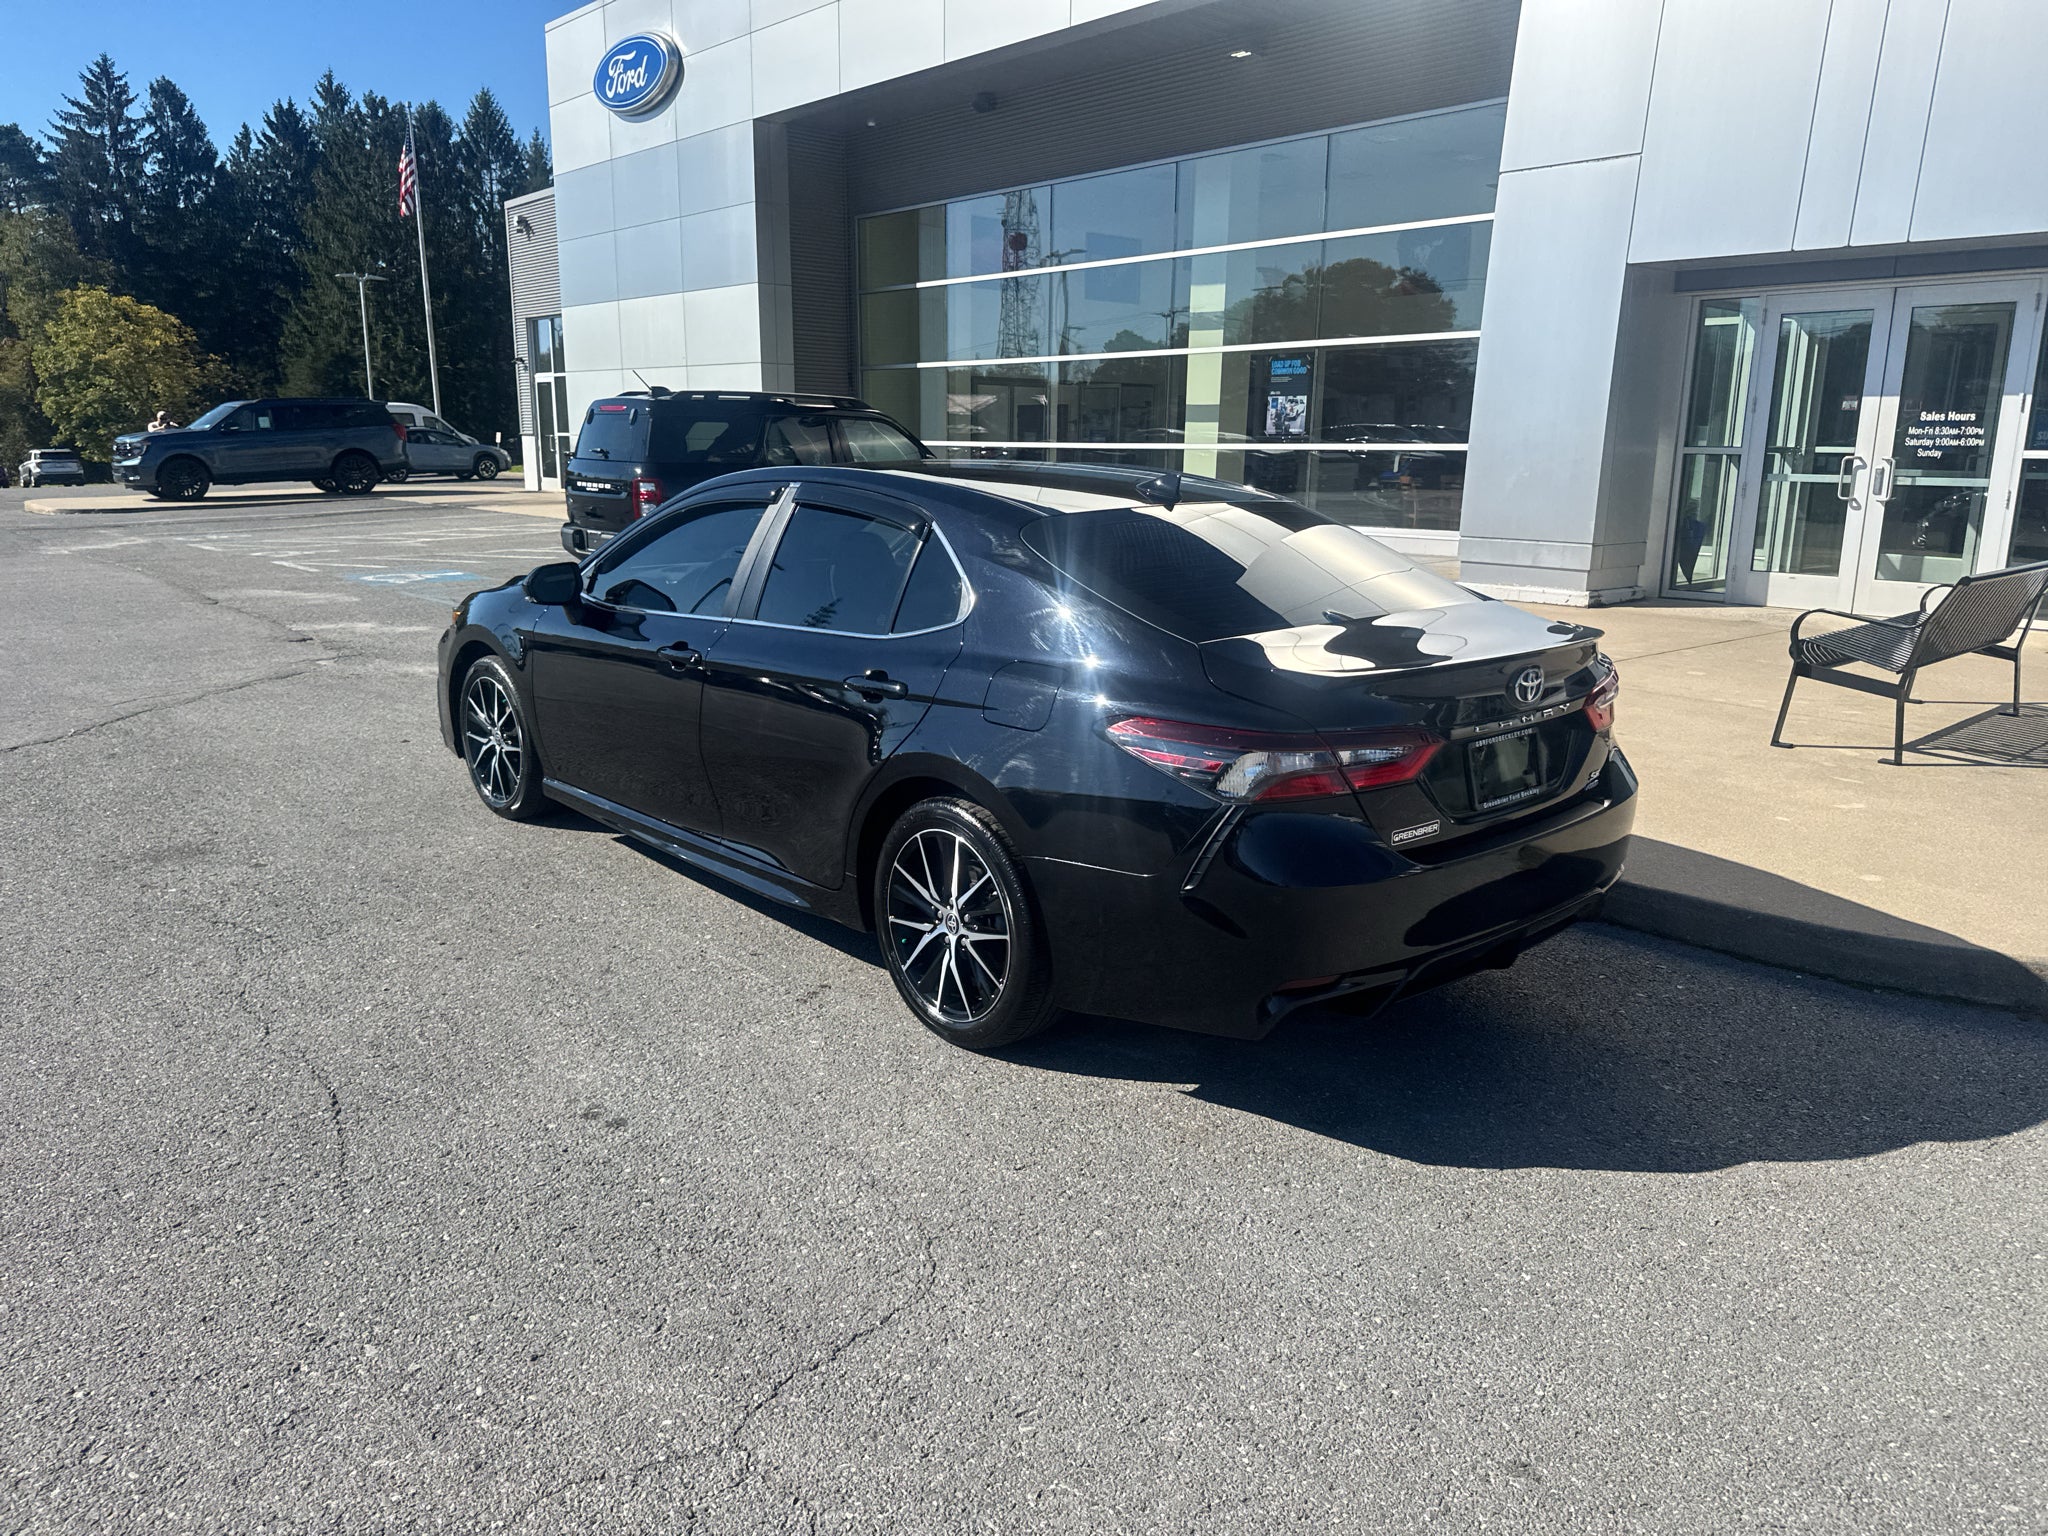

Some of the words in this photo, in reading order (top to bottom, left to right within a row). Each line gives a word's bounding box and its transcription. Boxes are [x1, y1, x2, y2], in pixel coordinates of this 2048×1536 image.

[606, 50, 648, 98] Ford
[1920, 411, 1945, 421] Sales
[1948, 411, 1976, 421] Hours
[1908, 426, 1934, 435] Mon-Fri
[1935, 426, 1985, 435] 8:30AM-7:00PM
[1905, 437, 1934, 448] Saturday
[1935, 437, 1985, 447] 9:00AM-6:00PM
[1917, 448, 1943, 459] Sunday
[1393, 824, 1438, 841] GREENBRIER
